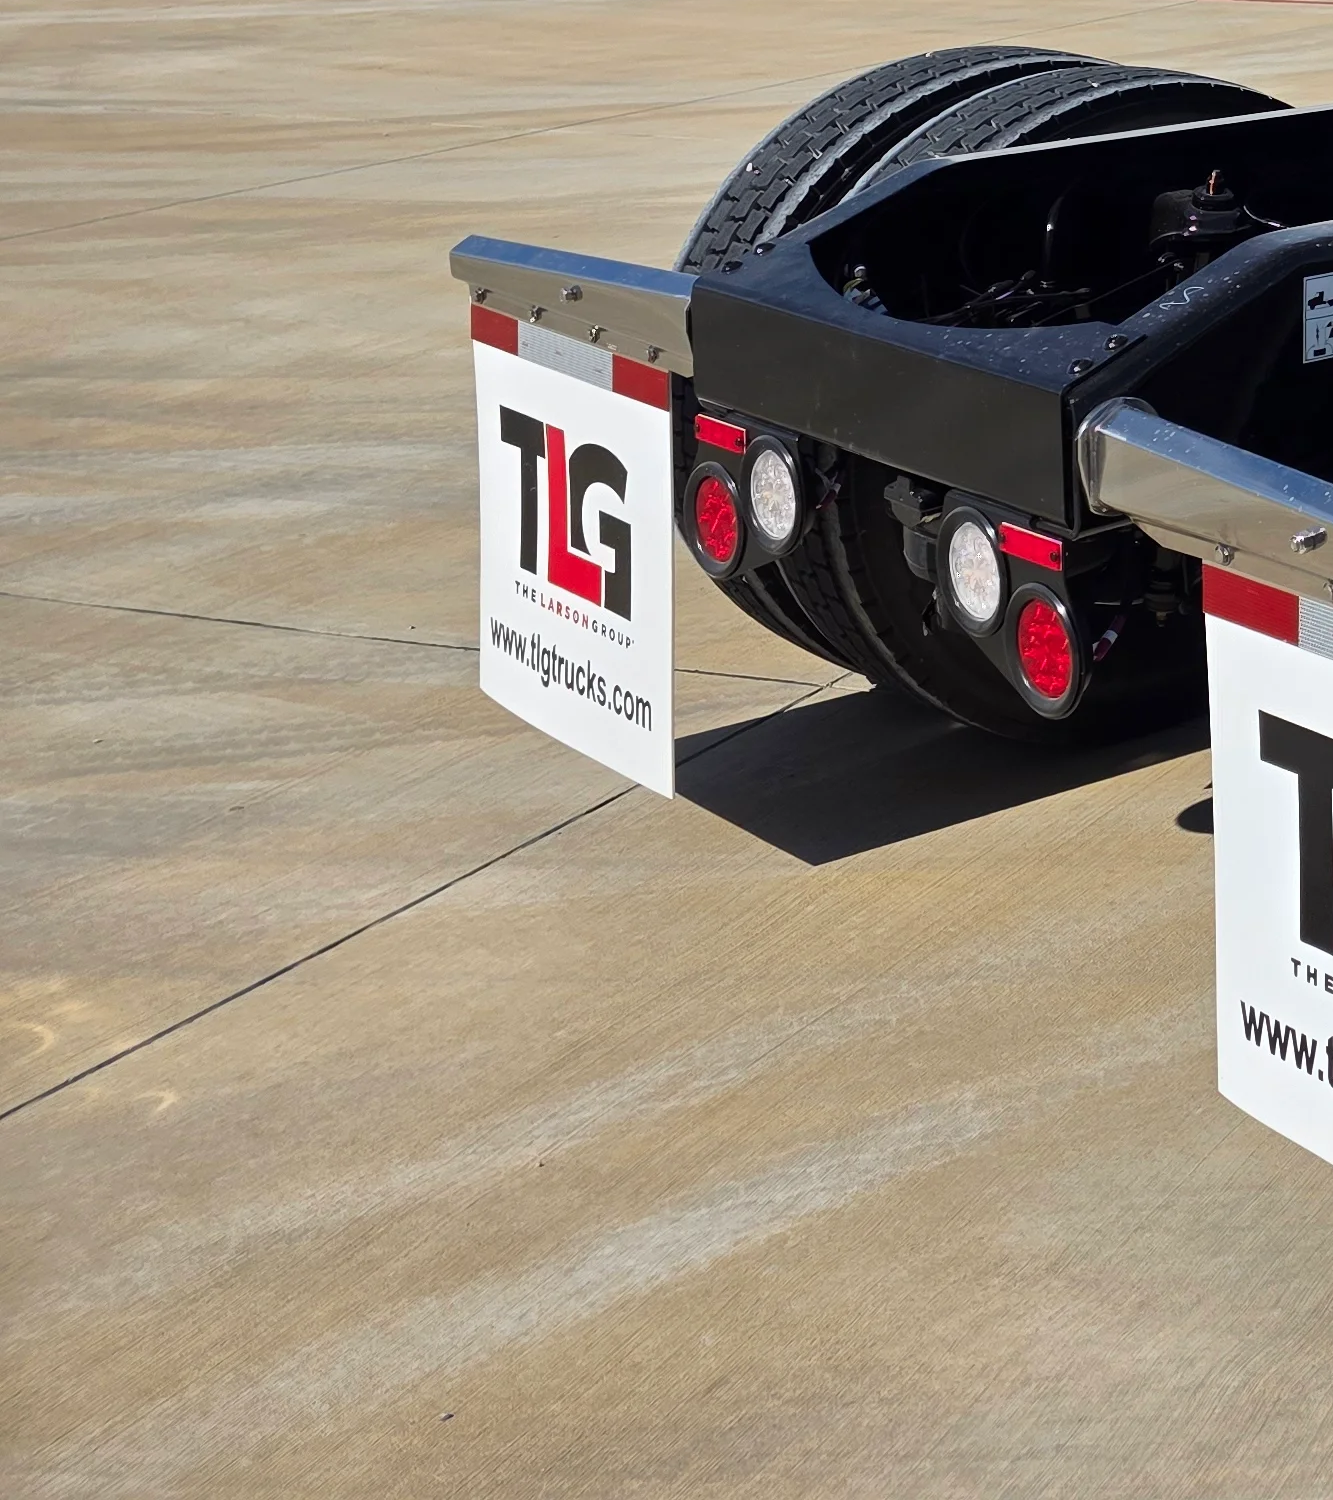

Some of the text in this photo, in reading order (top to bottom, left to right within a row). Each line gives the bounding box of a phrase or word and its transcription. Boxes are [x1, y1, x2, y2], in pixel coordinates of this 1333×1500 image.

[499, 405, 632, 622] TLG
[514, 579, 634, 649] THE LARSON GROUP
[490, 615, 653, 732] www.tlgtrucks.com
